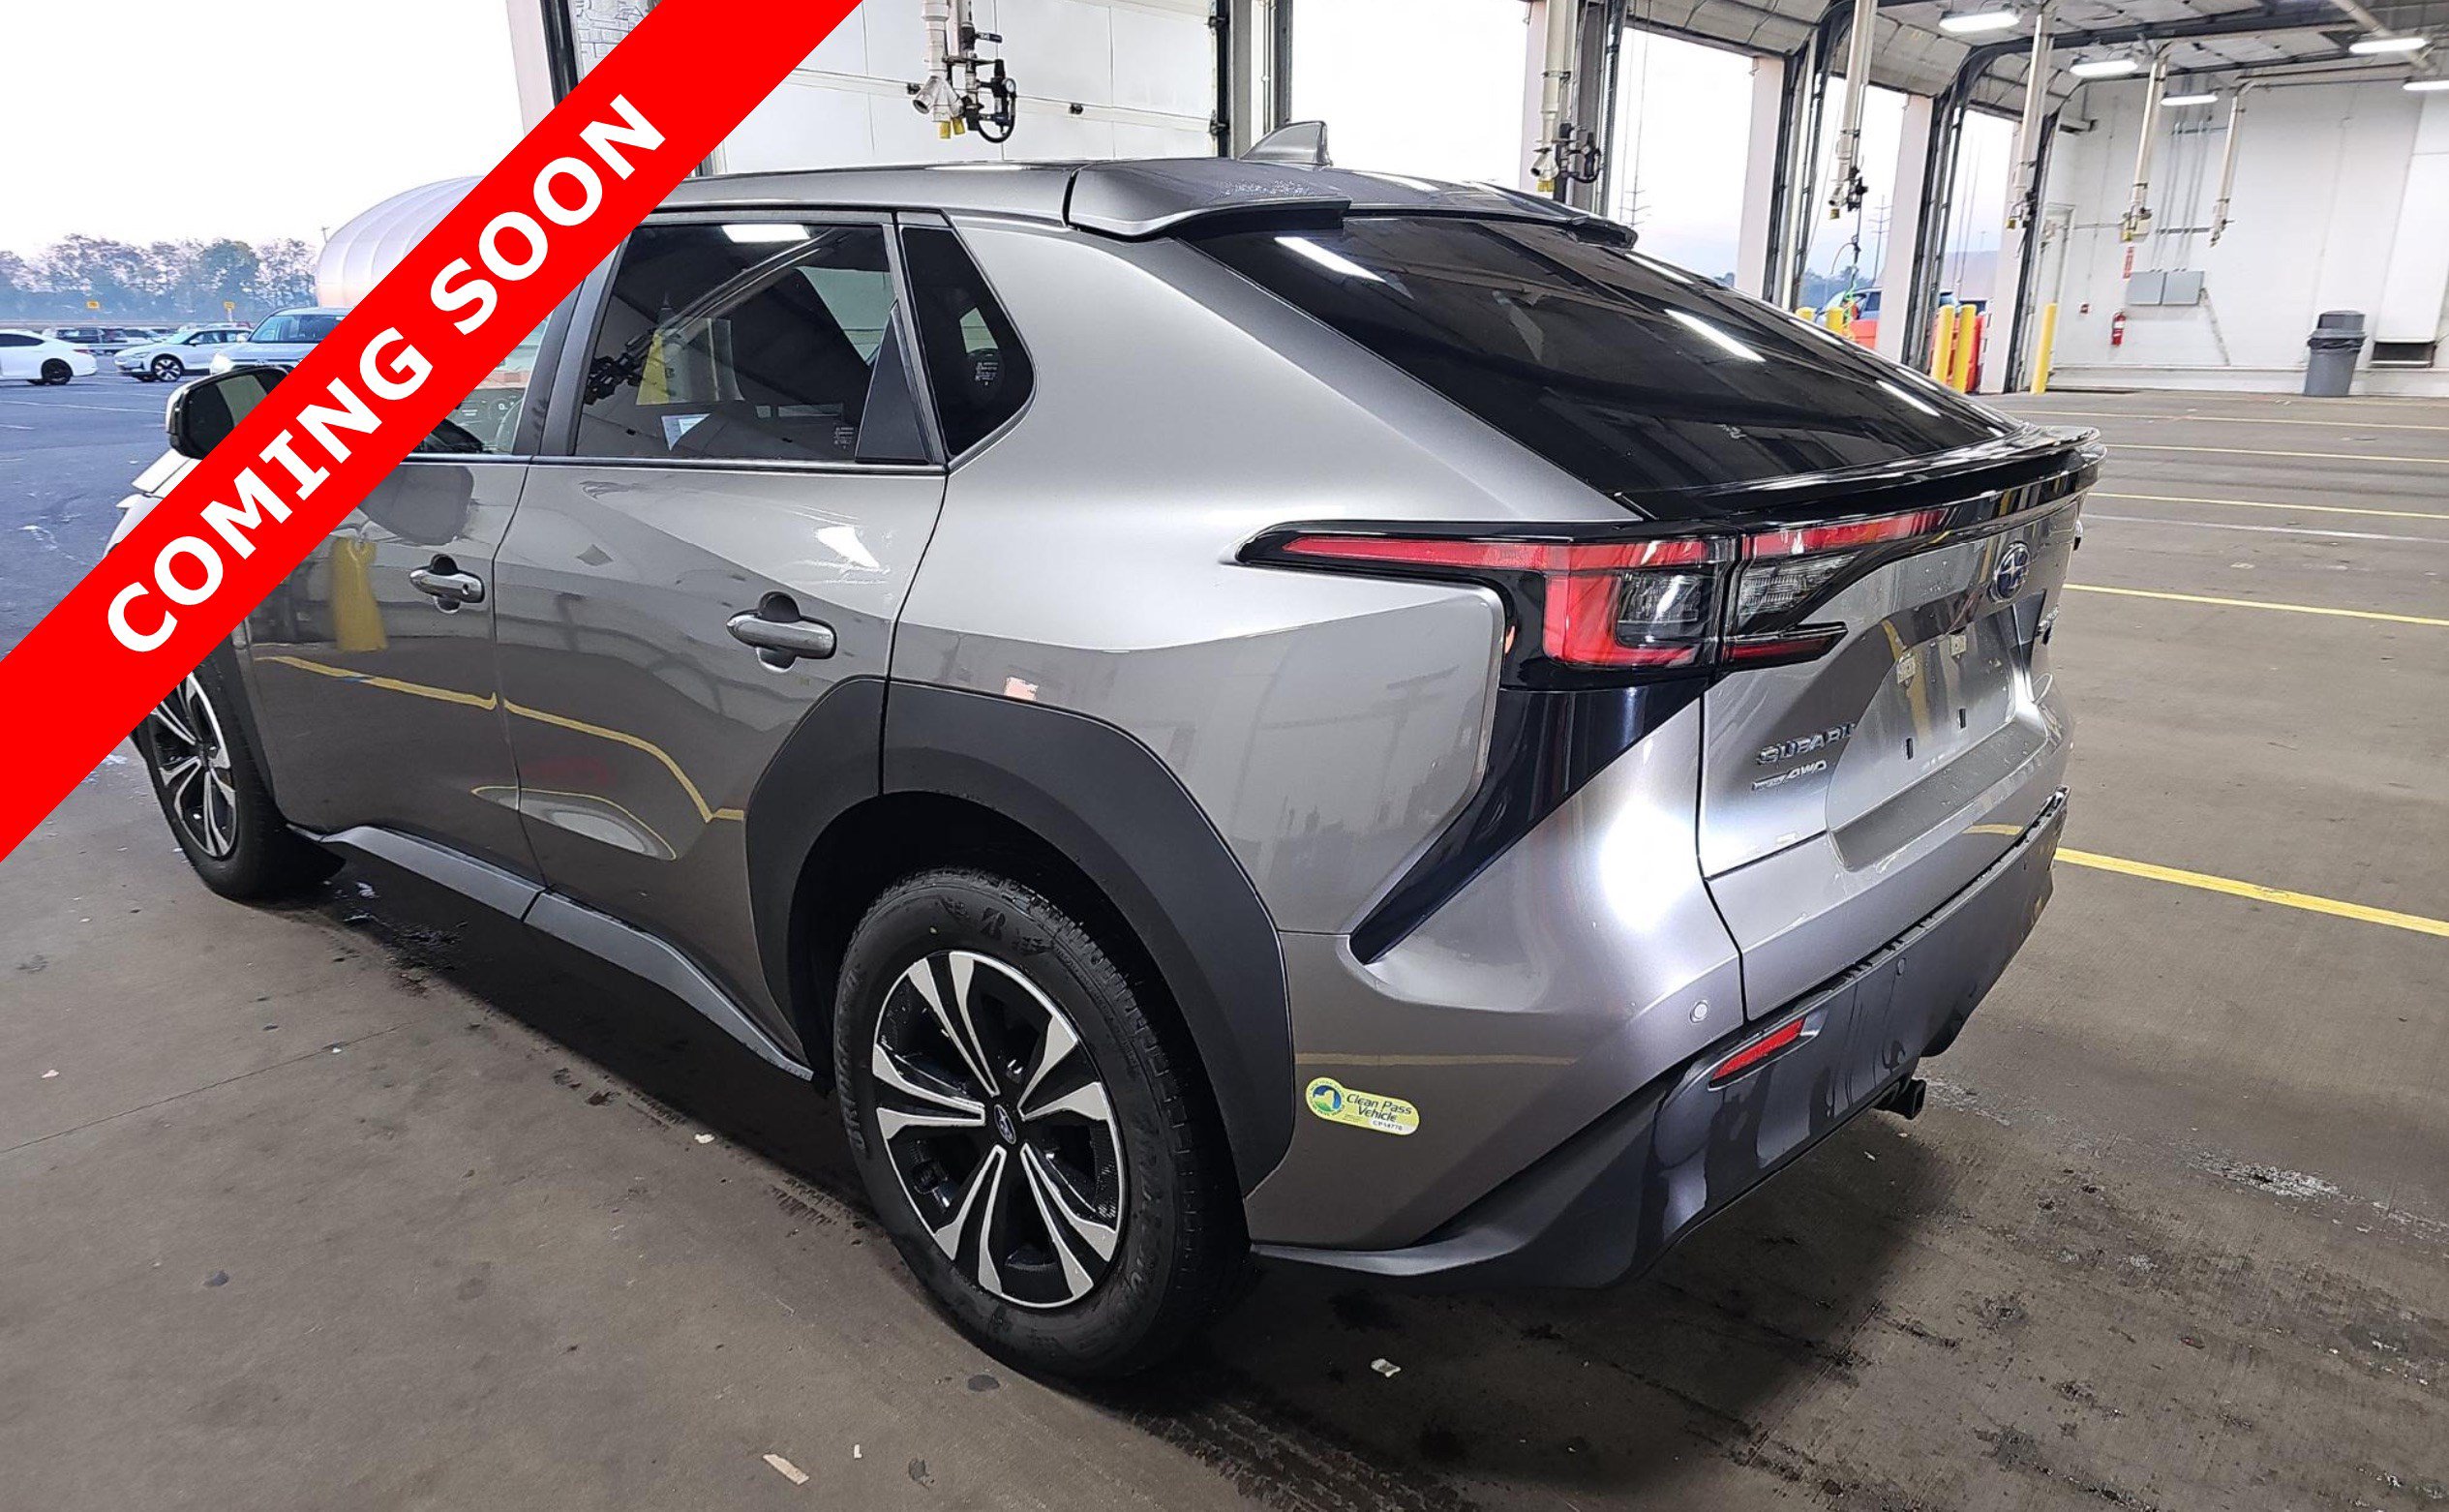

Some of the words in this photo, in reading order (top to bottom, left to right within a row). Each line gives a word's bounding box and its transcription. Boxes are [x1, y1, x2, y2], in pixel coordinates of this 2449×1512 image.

[1346, 1094, 1378, 1107] Clean
[1382, 1101, 1412, 1115] Pass
[1358, 1105, 1398, 1122] Vehicle
